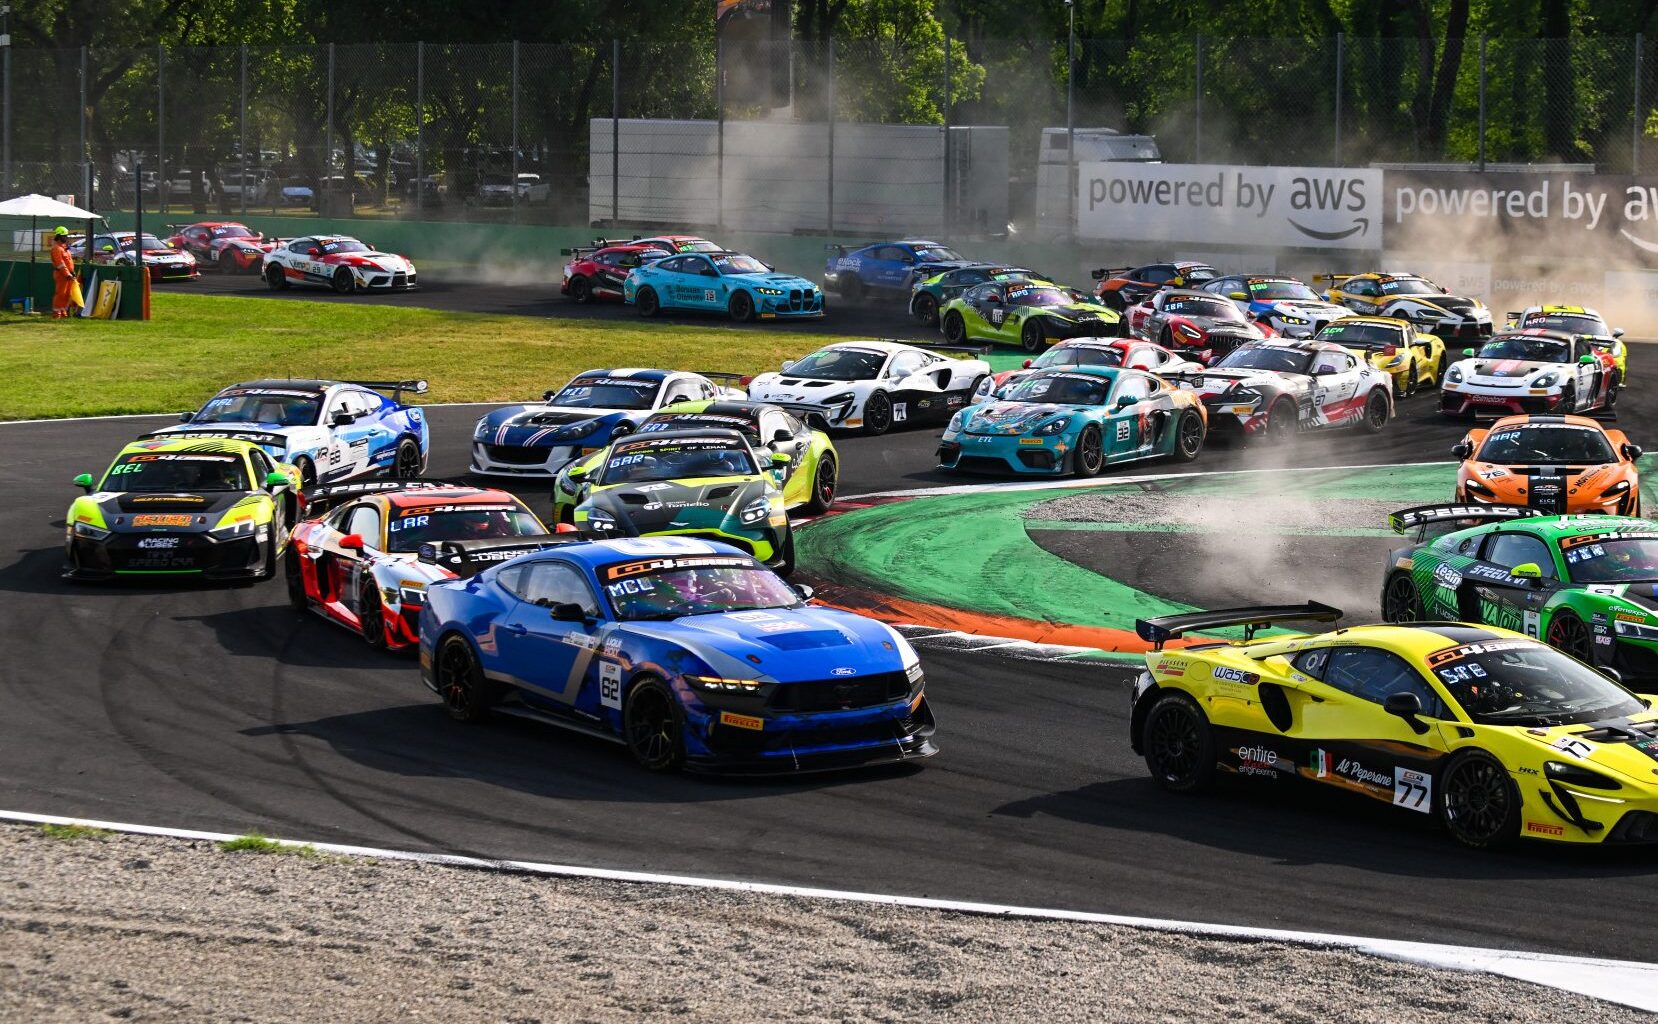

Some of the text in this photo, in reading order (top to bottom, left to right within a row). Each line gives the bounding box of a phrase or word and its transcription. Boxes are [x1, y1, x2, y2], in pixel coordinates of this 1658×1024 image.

[1089, 172, 1367, 217] powered by aws
[1396, 180, 1549, 223] powered
[1563, 181, 1608, 230] by
[1494, 279, 1546, 294] powered
[1117, 427, 1129, 440] 32
[111, 463, 143, 475] BEL
[610, 454, 644, 469] GAR
[390, 515, 429, 532] LAR
[607, 557, 753, 580] GT4 EUROPE
[1435, 562, 1462, 585] team
[1469, 564, 1508, 580] SPEED
[608, 577, 654, 597] MCL
[602, 676, 619, 700] 62
[724, 713, 761, 729] PIRELLI
[1238, 745, 1278, 764] entire
[1238, 764, 1278, 779] engineering
[1335, 759, 1350, 773] Al
[1351, 764, 1392, 787] Peperone
[1519, 766, 1539, 775] HRX
[1397, 780, 1428, 807] 77
[1528, 821, 1564, 836] PIRELLI
